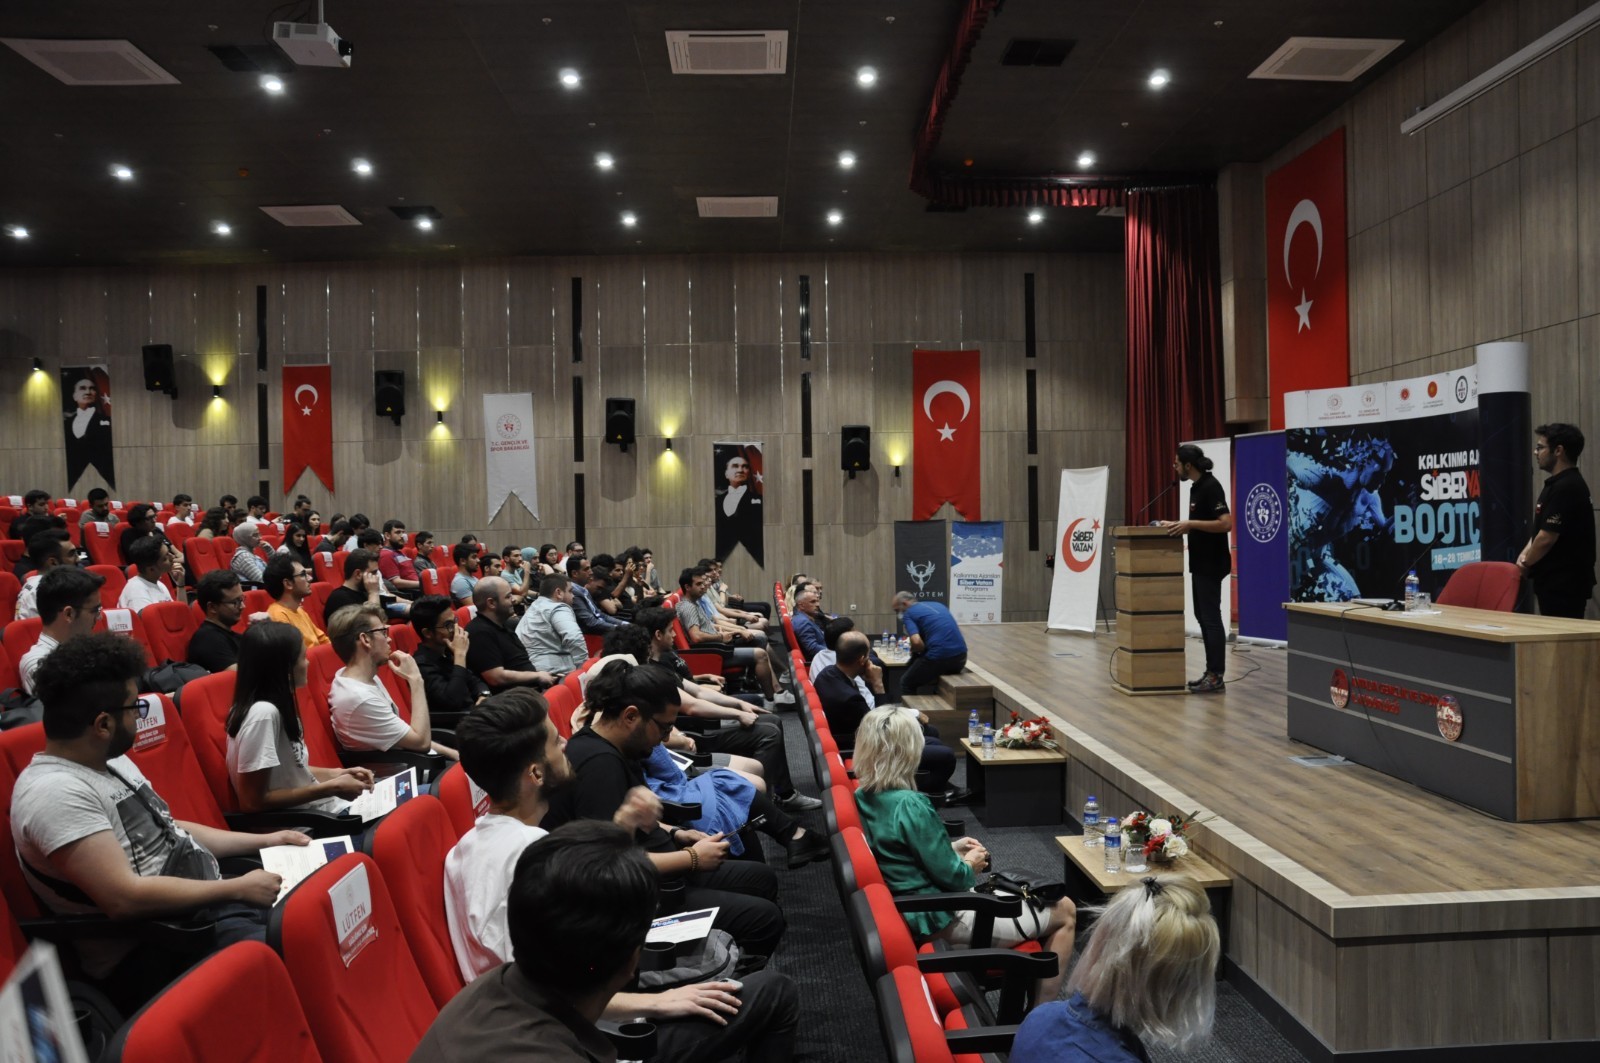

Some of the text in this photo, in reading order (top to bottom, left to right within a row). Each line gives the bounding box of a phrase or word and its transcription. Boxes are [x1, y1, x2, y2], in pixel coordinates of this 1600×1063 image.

[1418, 450, 1468, 470] KALKINMA
[1072, 530, 1094, 541] SİBER
[1072, 542, 1094, 552] VATAN
[341, 902, 366, 934] LÜTFEN
